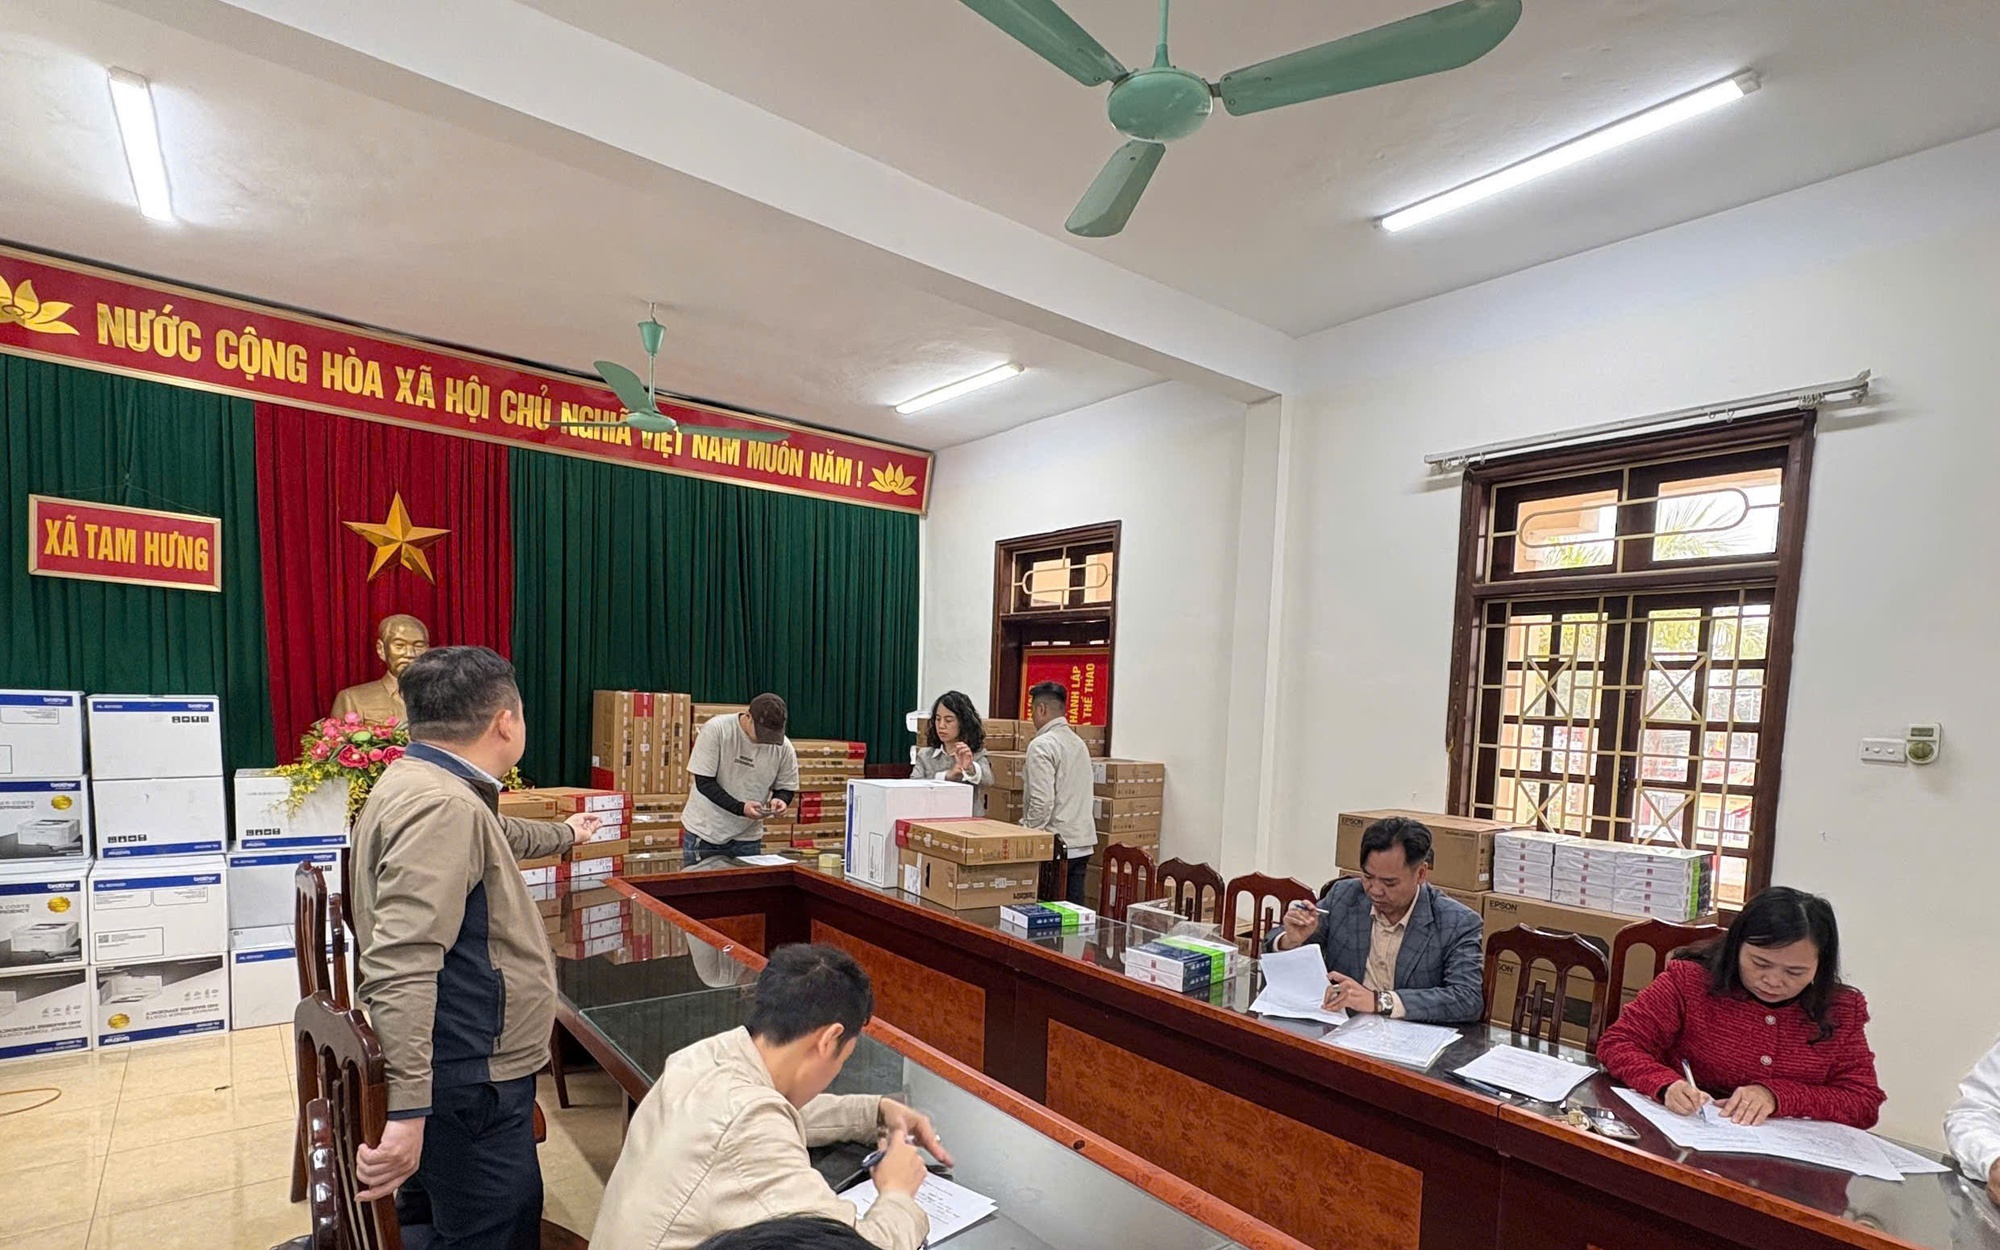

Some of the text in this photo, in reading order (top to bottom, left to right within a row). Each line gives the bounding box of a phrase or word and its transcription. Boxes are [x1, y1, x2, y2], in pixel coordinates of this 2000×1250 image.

[96, 302, 202, 363] NƯỚC
[215, 325, 308, 384] CỘNG
[321, 345, 384, 400] HÒA
[393, 365, 436, 410] XÃ
[445, 374, 490, 424] HỘI
[499, 384, 551, 430] CHỦ
[559, 401, 632, 447] NGHĨA
[691, 432, 740, 466] NAM
[746, 440, 802, 478] MUÔN
[809, 449, 852, 487] NĂM
[856, 460, 864, 488] !
[43, 514, 209, 572] XÃ TAM HƯNG
[1084, 663, 1095, 693] THAO
[1068, 691, 1079, 723] HÀNH
[1341, 817, 1363, 826] EPSON
[1489, 899, 1518, 911] EPSON
[103, 1035, 130, 1044] brother
